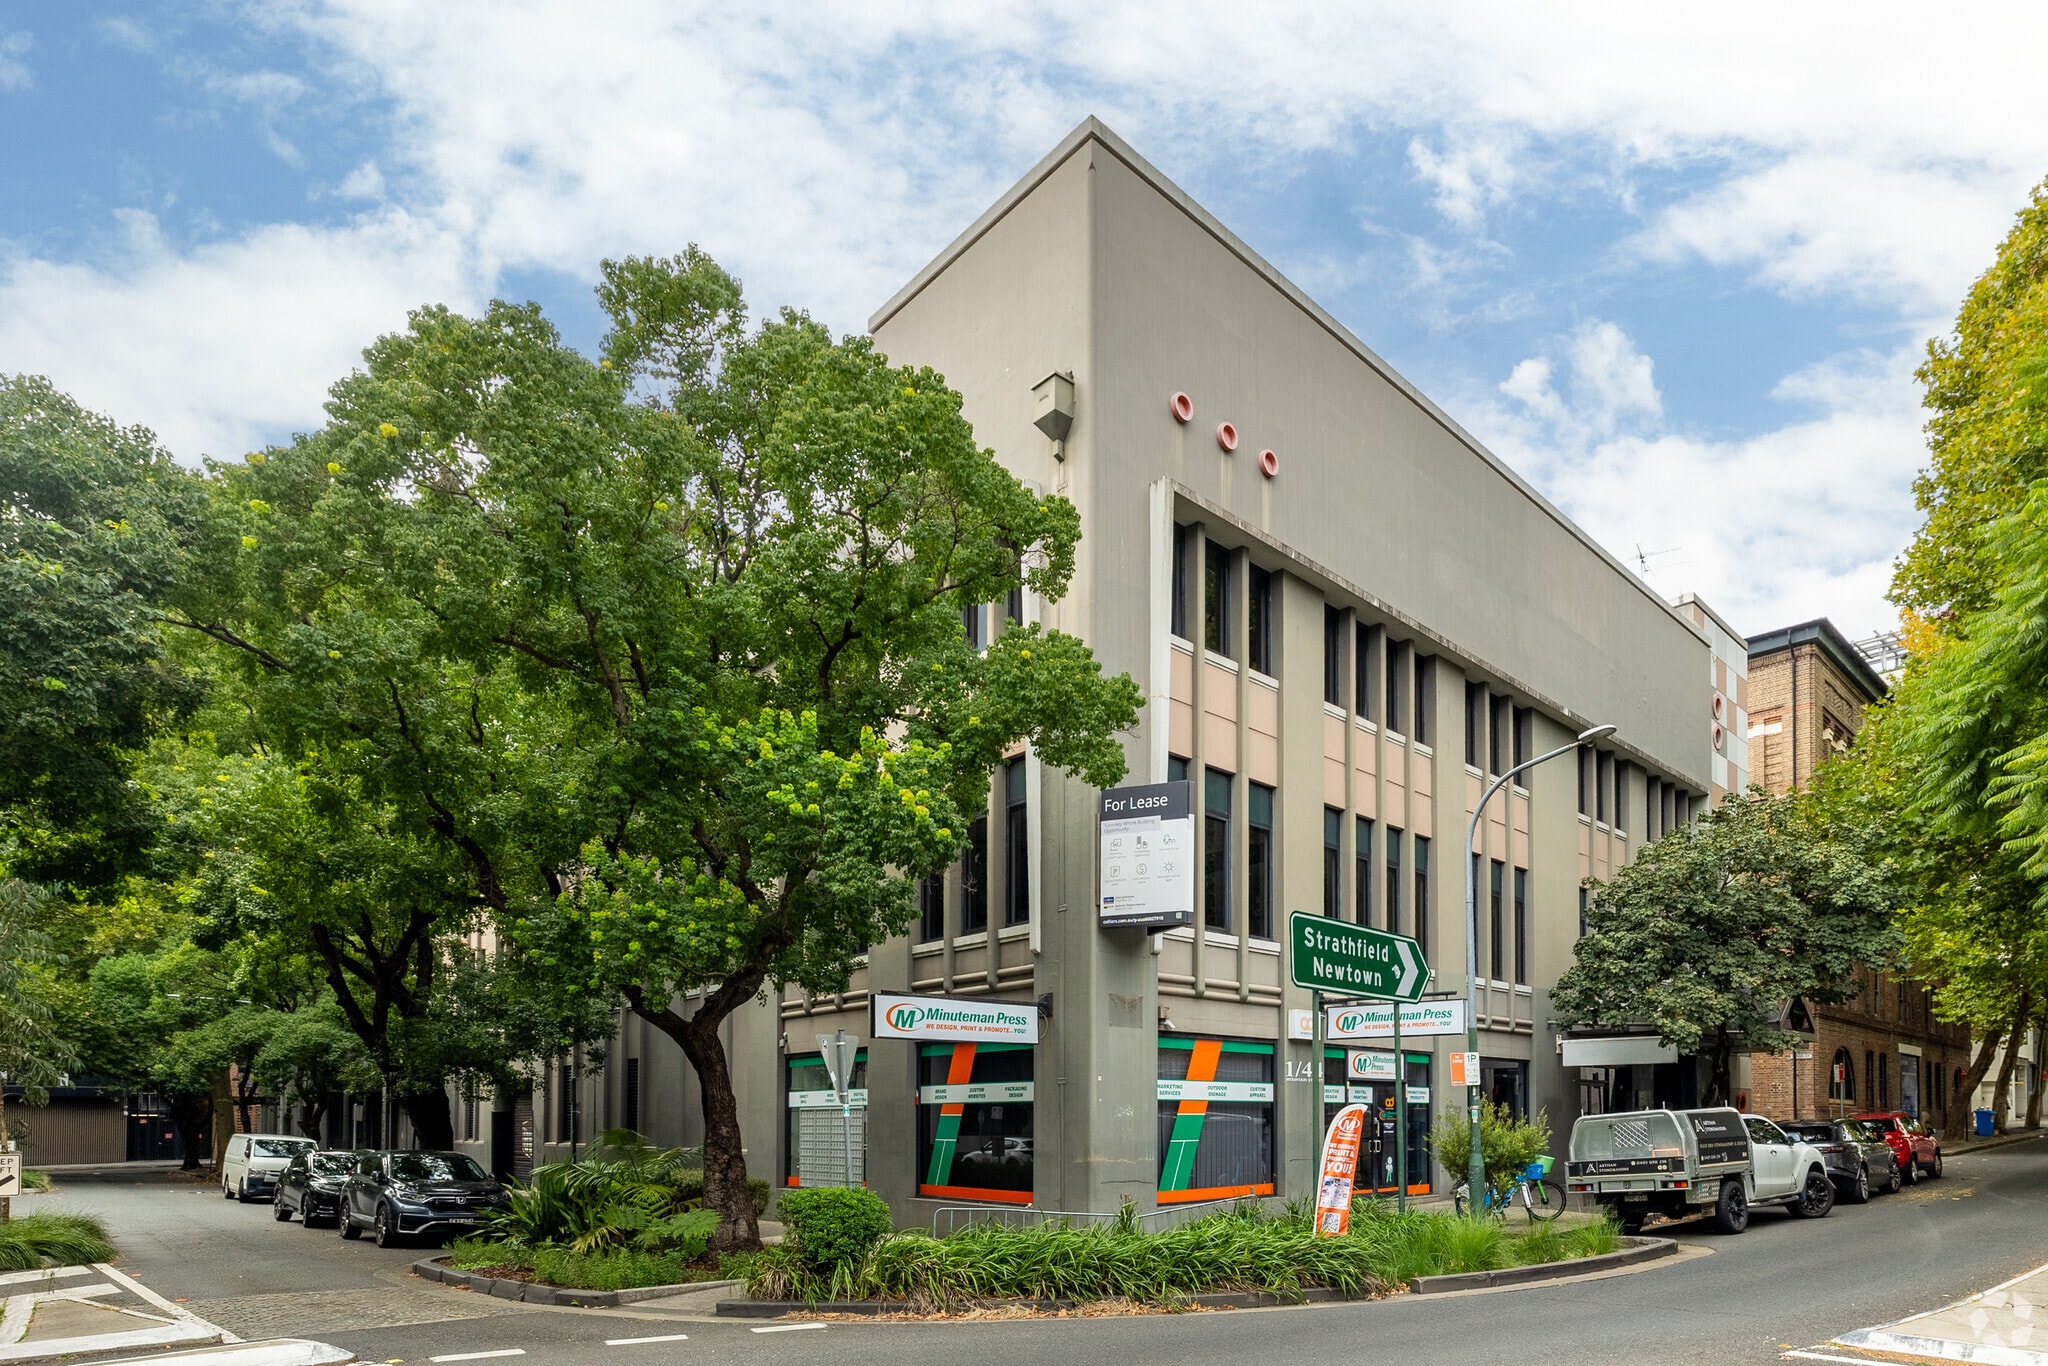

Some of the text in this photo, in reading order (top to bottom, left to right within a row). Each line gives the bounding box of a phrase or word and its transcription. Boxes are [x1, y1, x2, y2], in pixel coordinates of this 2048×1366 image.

[1104, 796, 1168, 812] For Lease
[1104, 826, 1130, 834] Opportunity
[1304, 926, 1388, 962] Strathfield
[1314, 956, 1382, 986] Newtown
[926, 1008, 1028, 1026] Minuteman Press
[1364, 1008, 1452, 1022] Minutman Press
[1328, 1148, 1349, 1157] PRINT
[1326, 1161, 1353, 1174] YOU!
